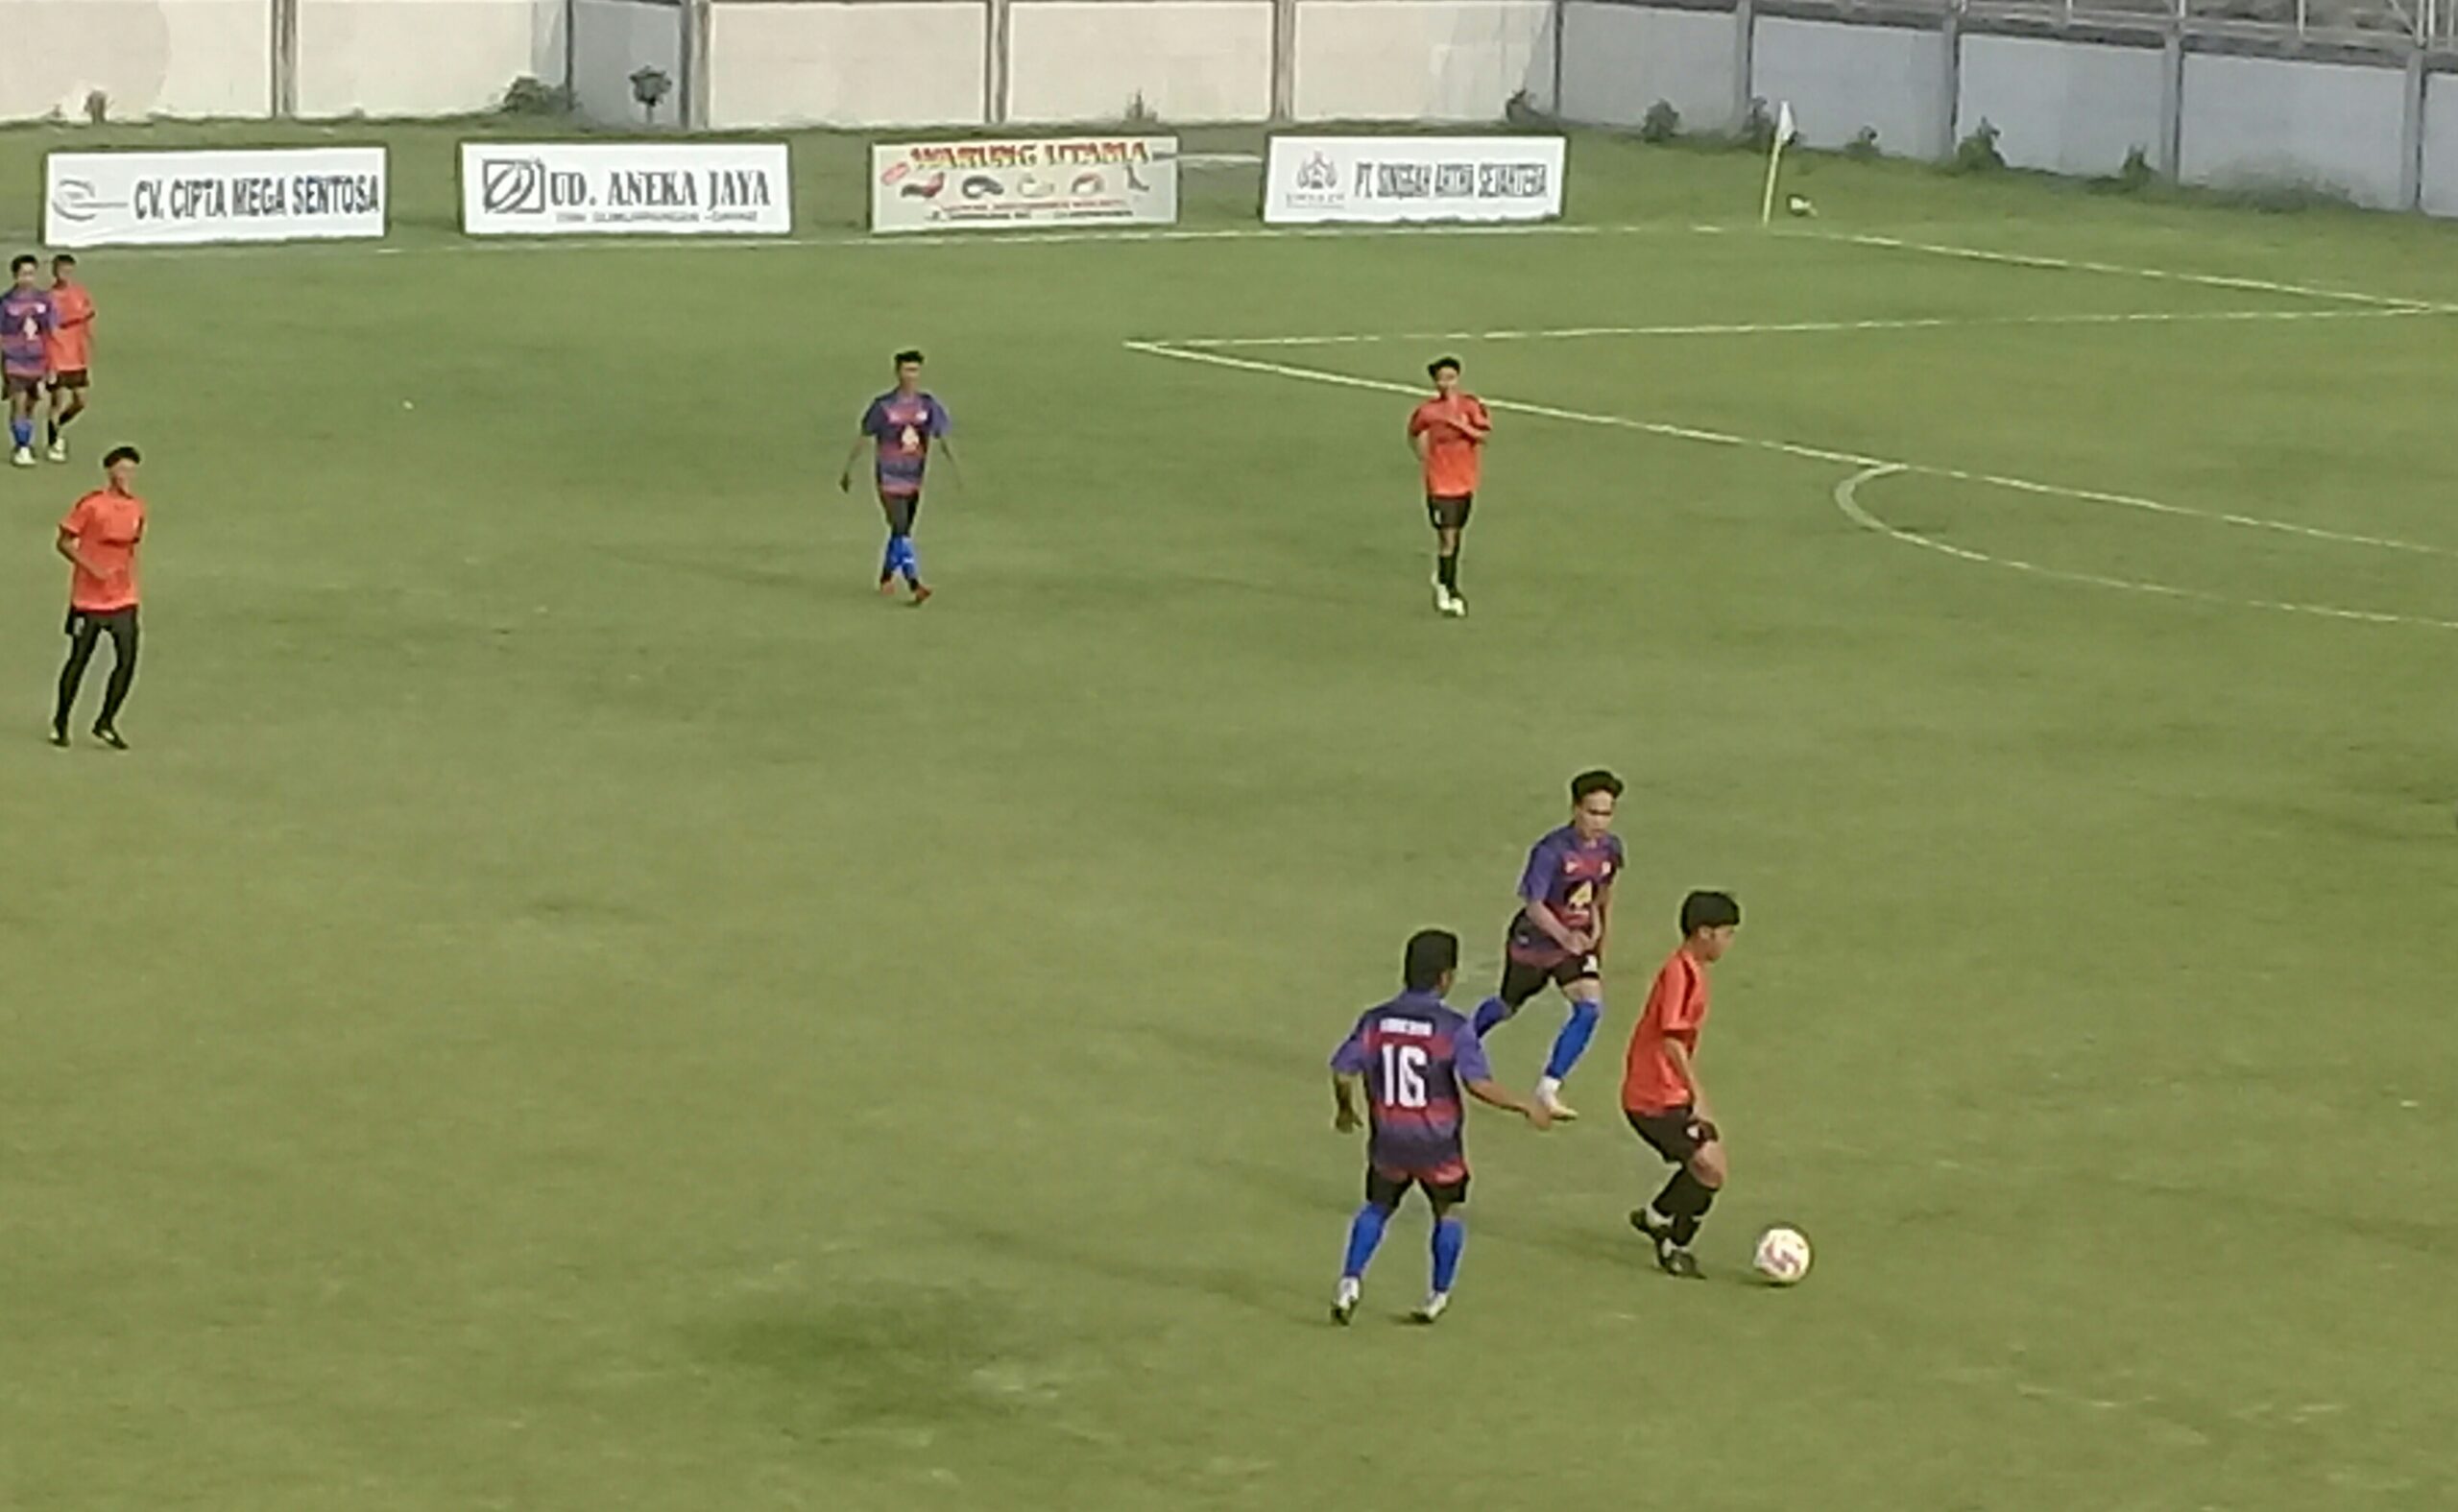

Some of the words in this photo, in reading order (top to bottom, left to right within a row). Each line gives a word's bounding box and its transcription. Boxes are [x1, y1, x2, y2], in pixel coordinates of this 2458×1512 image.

[1045, 141, 1150, 165] UTAMA
[133, 180, 164, 220] CV.
[170, 178, 228, 219] CIPTA
[232, 177, 287, 217] MEGA
[292, 175, 380, 215] SENTOSA
[550, 172, 597, 206] UD.
[608, 171, 699, 206] ANEKA
[708, 170, 772, 210] JAYA
[1381, 1043, 1429, 1108] 16
